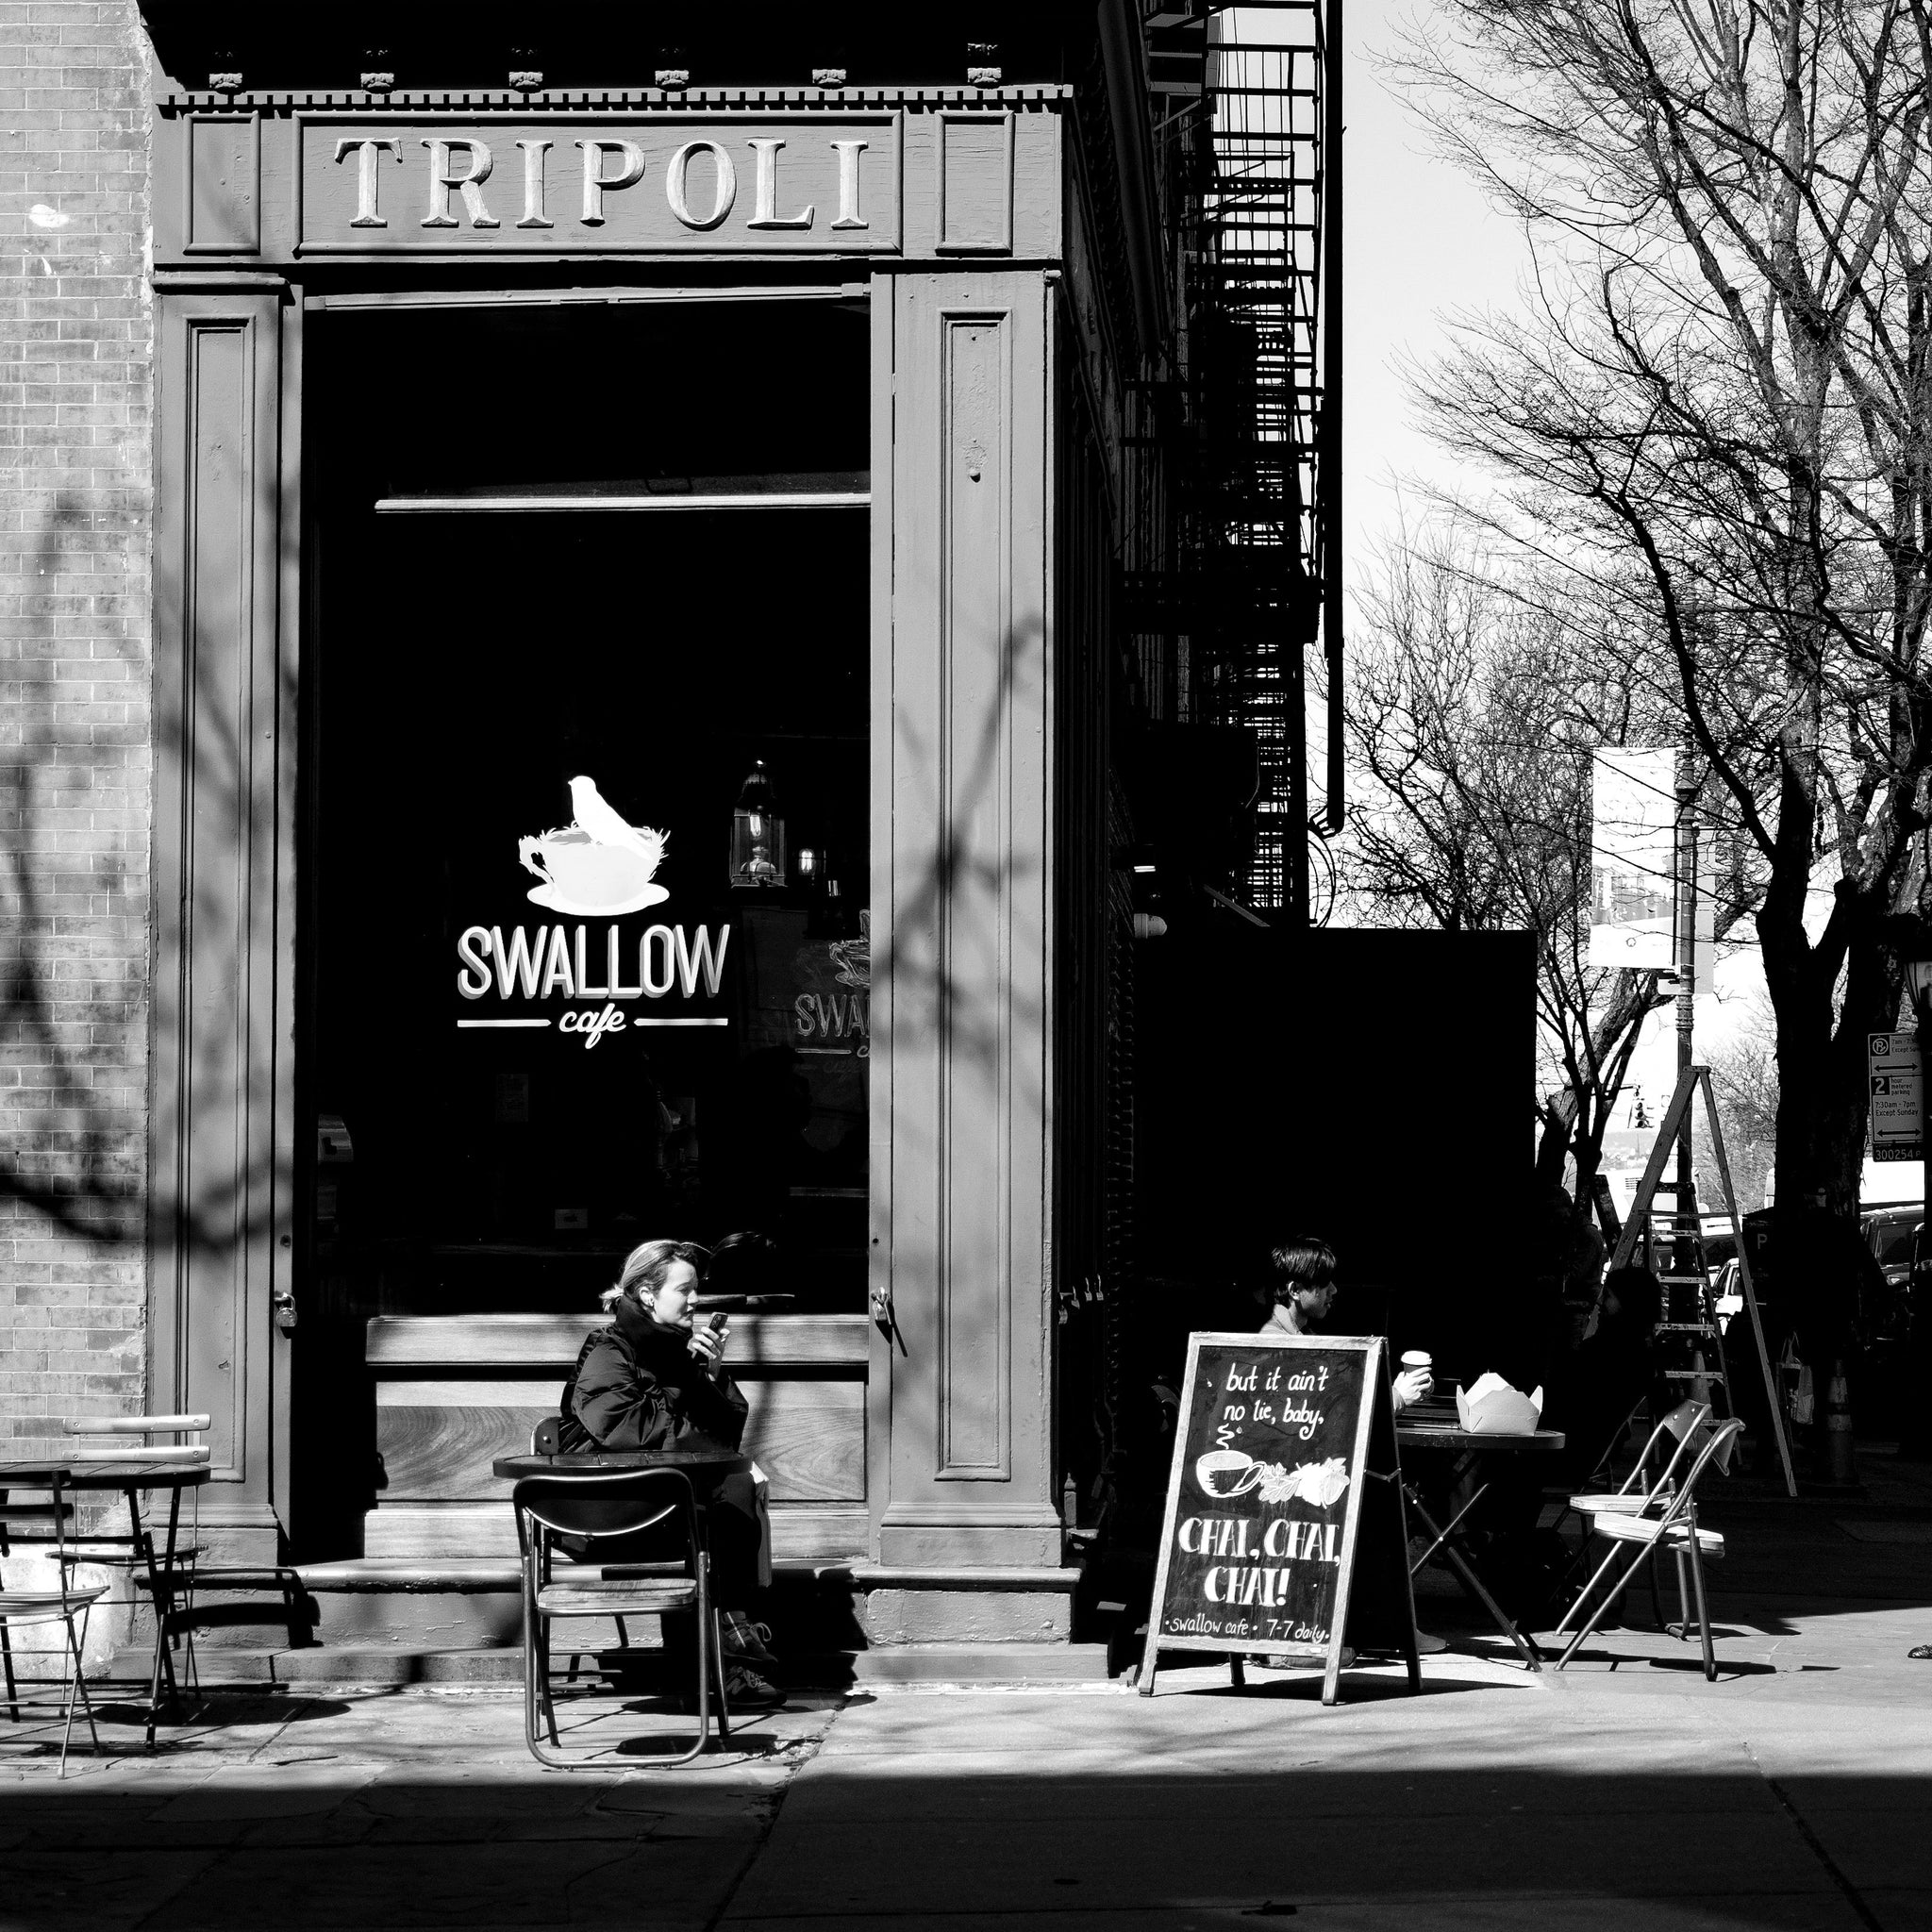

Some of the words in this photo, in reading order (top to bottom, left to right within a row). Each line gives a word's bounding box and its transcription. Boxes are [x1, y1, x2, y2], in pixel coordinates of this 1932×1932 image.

[334, 137, 869, 231] TRIPOLI
[457, 924, 730, 1000] SWALLOW
[558, 1003, 626, 1049] cafe
[794, 993, 870, 1038] SWA
[1874, 1077, 1886, 1095] 2
[1903, 1100, 1916, 1108] 7pm
[1875, 1149, 1914, 1160] 300254
[1757, 1233, 1768, 1250] P
[1226, 1362, 1258, 1391] but
[1266, 1366, 1281, 1391] it
[1288, 1365, 1329, 1391] ain't
[1224, 1405, 1245, 1421] no
[1253, 1399, 1276, 1424] lie,
[1283, 1397, 1324, 1441] baby,
[1178, 1517, 1260, 1560] CHAI,
[1263, 1518, 1341, 1567] CHAI,
[1204, 1566, 1291, 1607] CHAI!
[1170, 1612, 1222, 1633] swallow
[1225, 1618, 1248, 1635] cafe
[1266, 1619, 1293, 1638] 7-7
